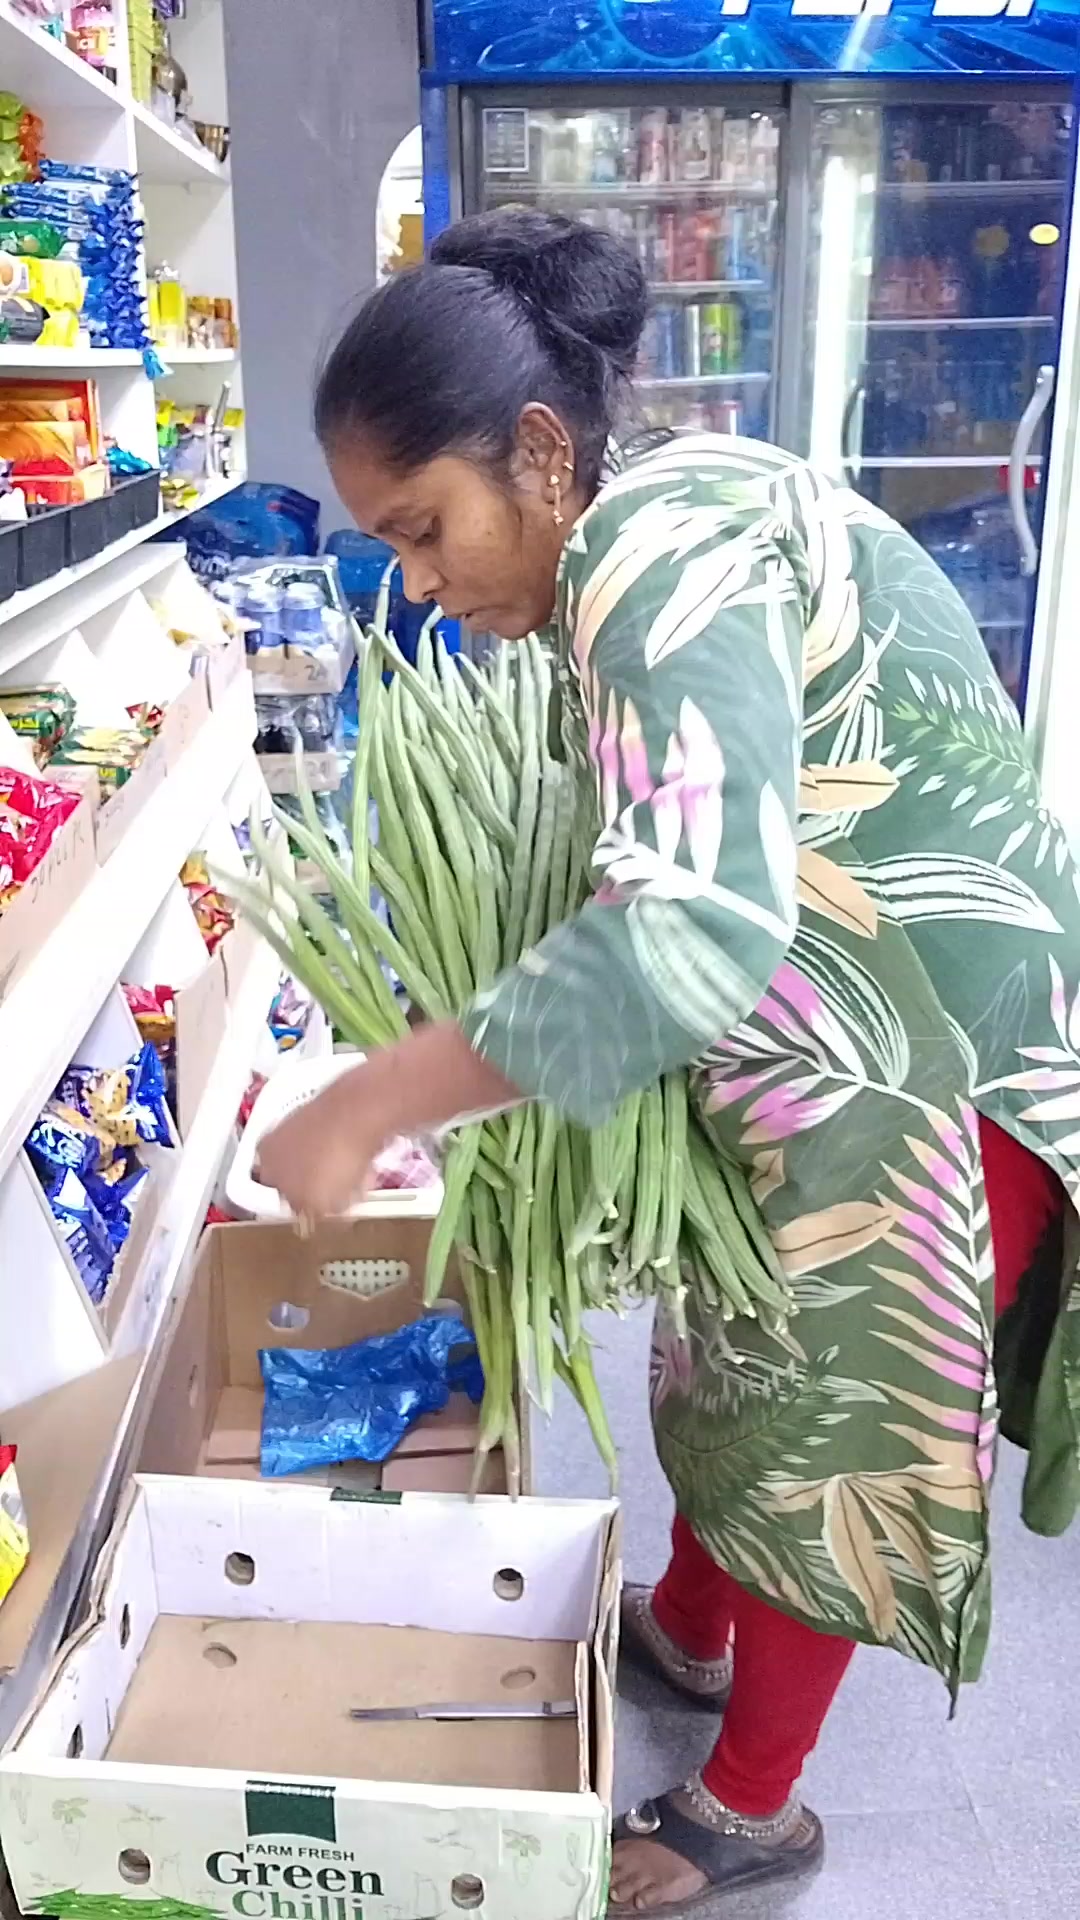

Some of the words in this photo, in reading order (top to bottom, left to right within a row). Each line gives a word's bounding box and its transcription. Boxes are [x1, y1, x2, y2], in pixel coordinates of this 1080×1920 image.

[246, 1843, 293, 1857] FARM
[298, 1847, 355, 1862] FRESH
[205, 1850, 385, 1896] Green
[232, 1889, 364, 1920] Chilli
